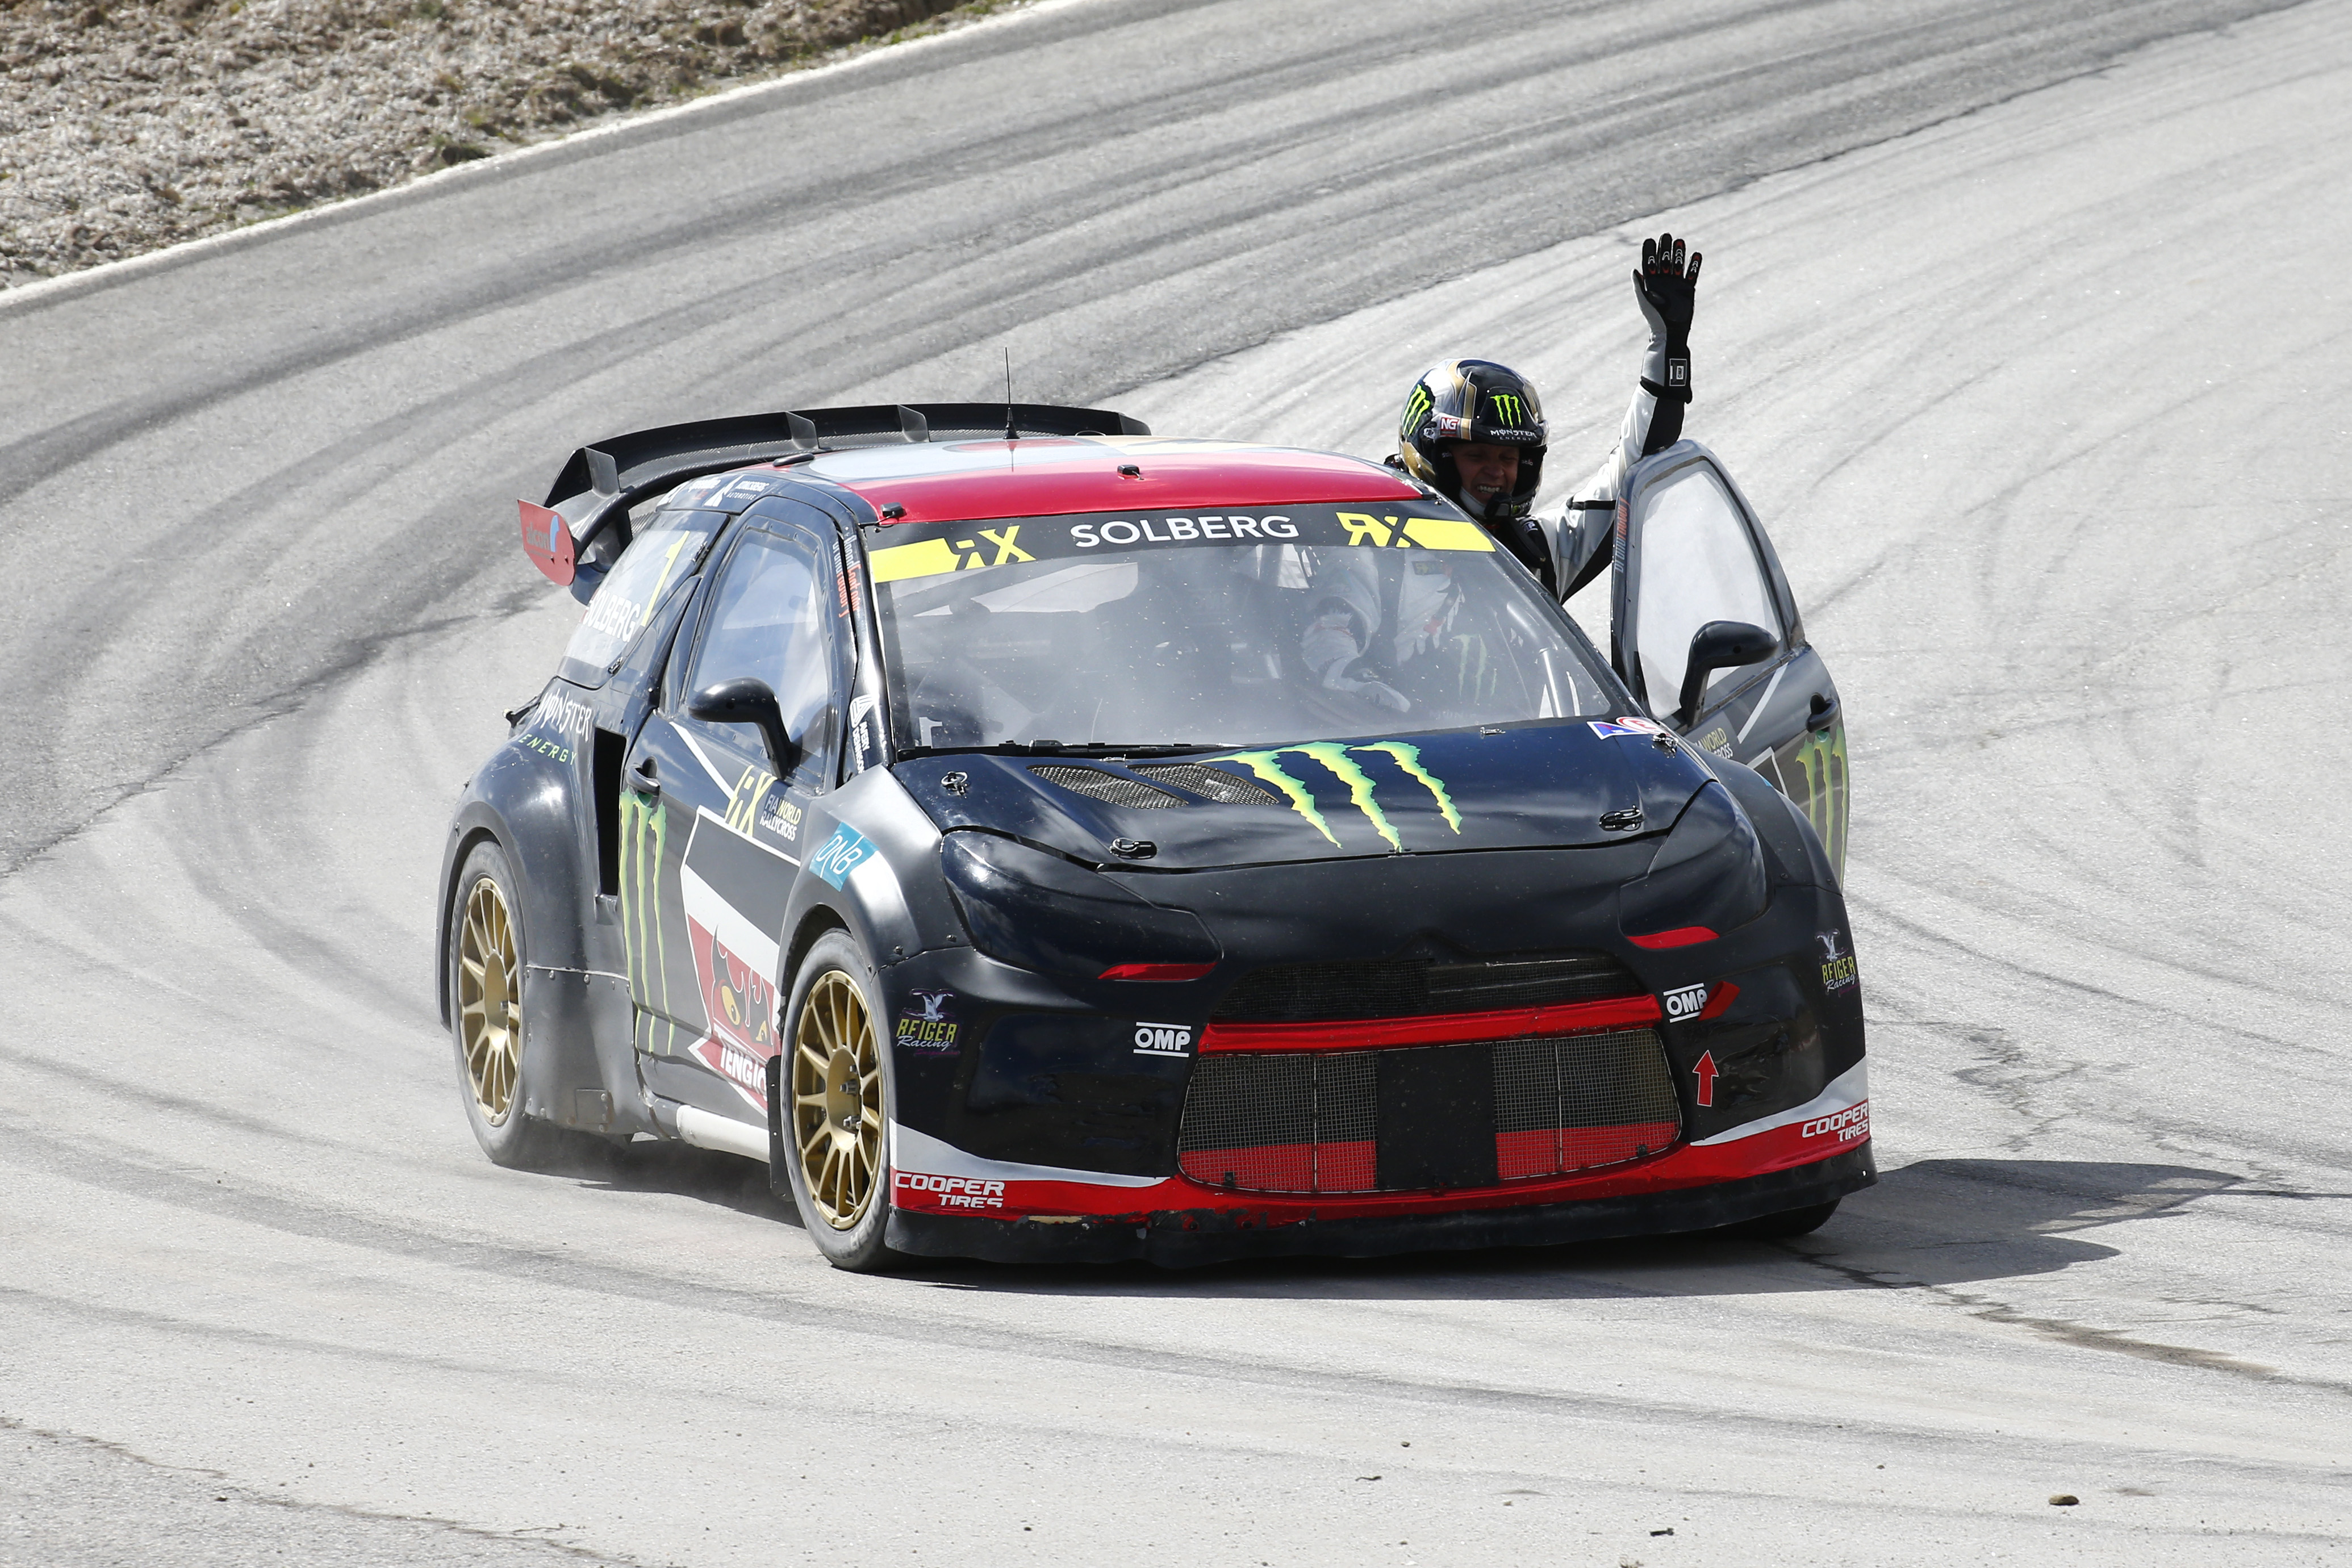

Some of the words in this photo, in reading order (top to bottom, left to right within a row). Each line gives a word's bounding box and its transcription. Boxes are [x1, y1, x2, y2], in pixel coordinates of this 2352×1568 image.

[1441, 418, 1458, 430] NG
[1070, 514, 1300, 548] SOLBERG
[640, 530, 689, 627] 1
[533, 688, 592, 743] MONSTER
[518, 734, 577, 765] ENERGY
[859, 721, 871, 751] AVERY
[765, 794, 779, 814] FIA
[776, 800, 802, 825] WORLD
[759, 810, 797, 842] RALLYCROSS
[816, 834, 863, 878] DNB
[1825, 974, 1856, 993] Racing
[1666, 988, 1708, 1016] OMP
[896, 1035, 951, 1051] Racing
[1134, 1028, 1190, 1051] OMP
[1802, 1102, 1868, 1139] COOPER
[1837, 1119, 1869, 1142] TIRES
[895, 1172, 1005, 1196] COOPER
[938, 1193, 1004, 1209] TIRES
